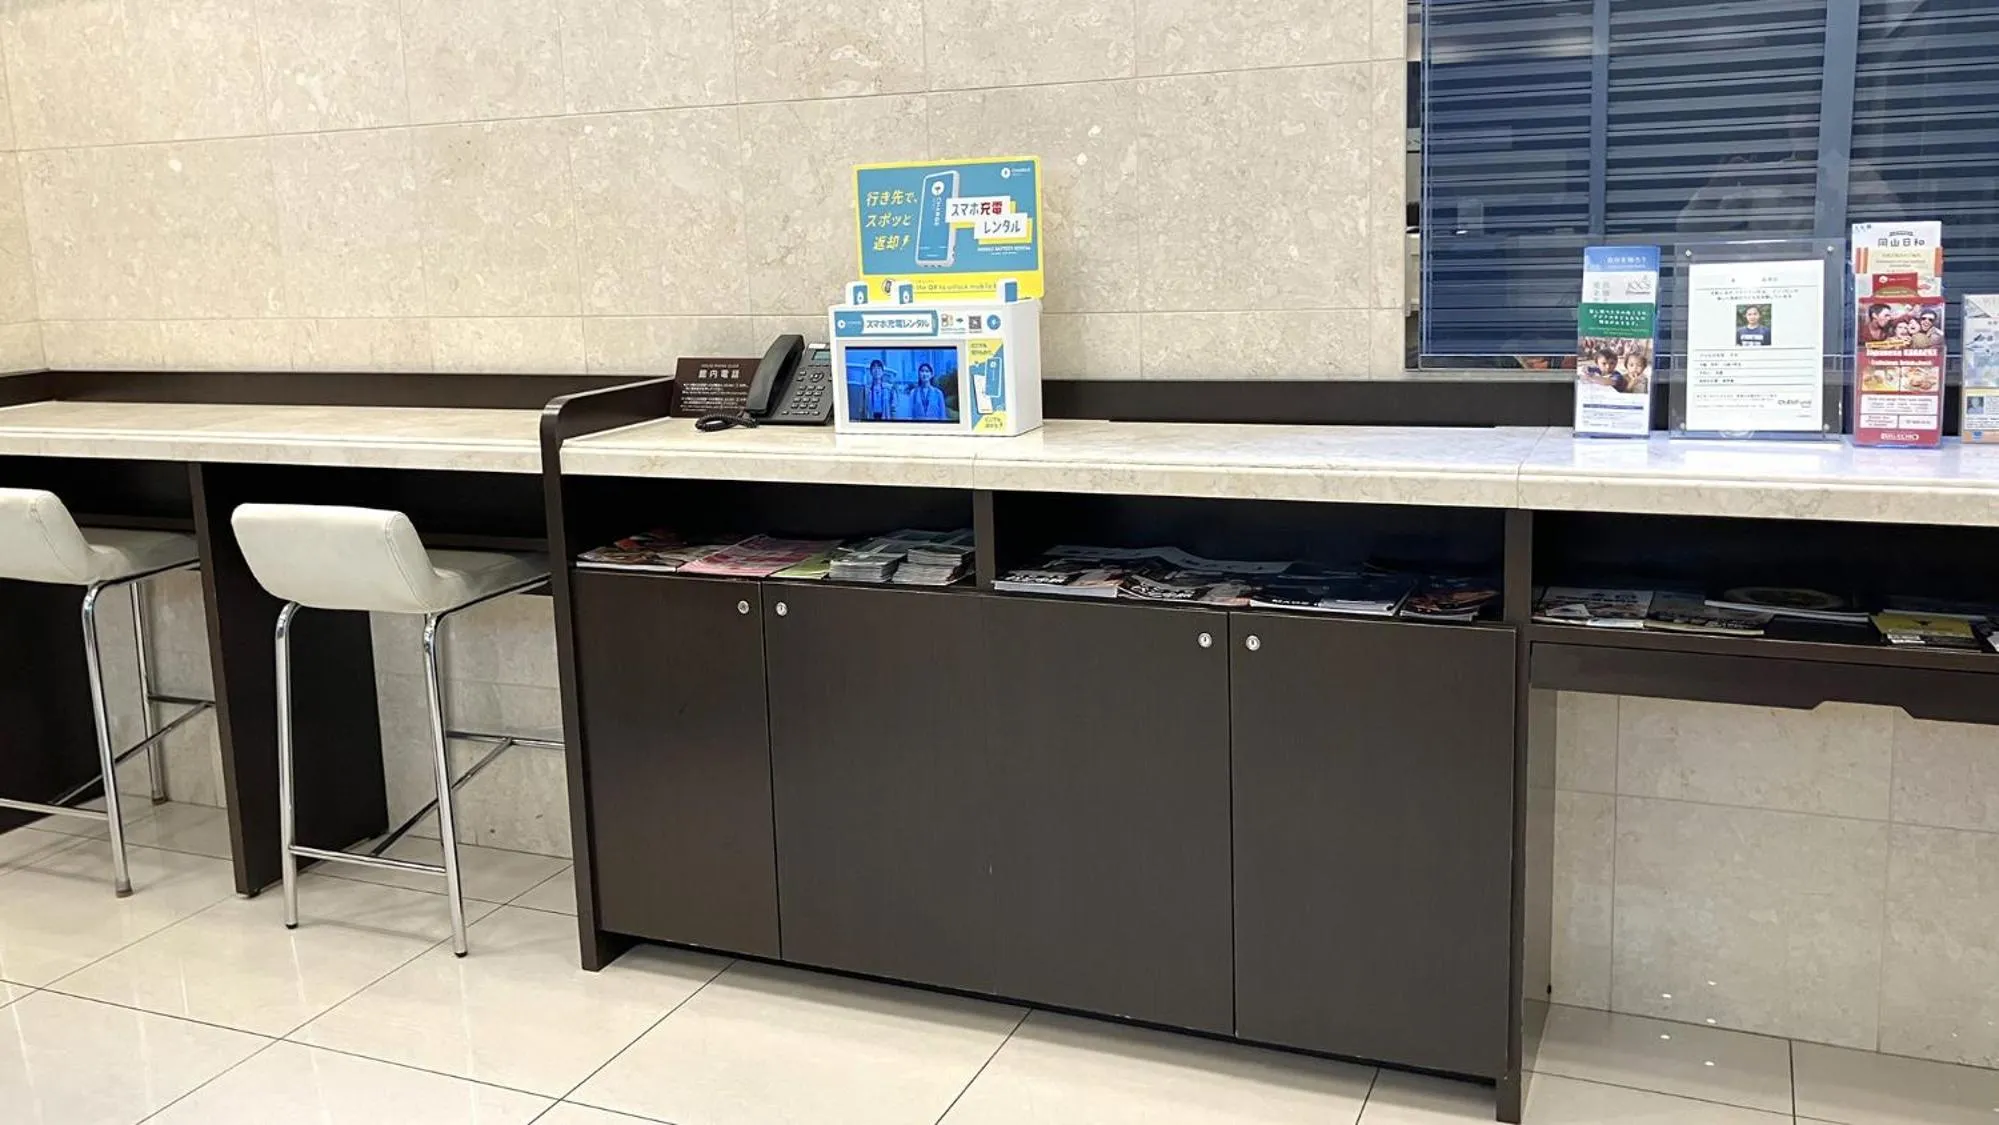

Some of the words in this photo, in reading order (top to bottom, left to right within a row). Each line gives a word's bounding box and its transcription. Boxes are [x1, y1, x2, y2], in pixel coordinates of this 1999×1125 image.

[866, 189, 918, 208] 行き先で、
[951, 200, 1003, 216] スマホ充電
[866, 211, 912, 228] スポッと
[984, 219, 1021, 234] レンタル
[866, 319, 930, 329] スマホ充電レンタル
